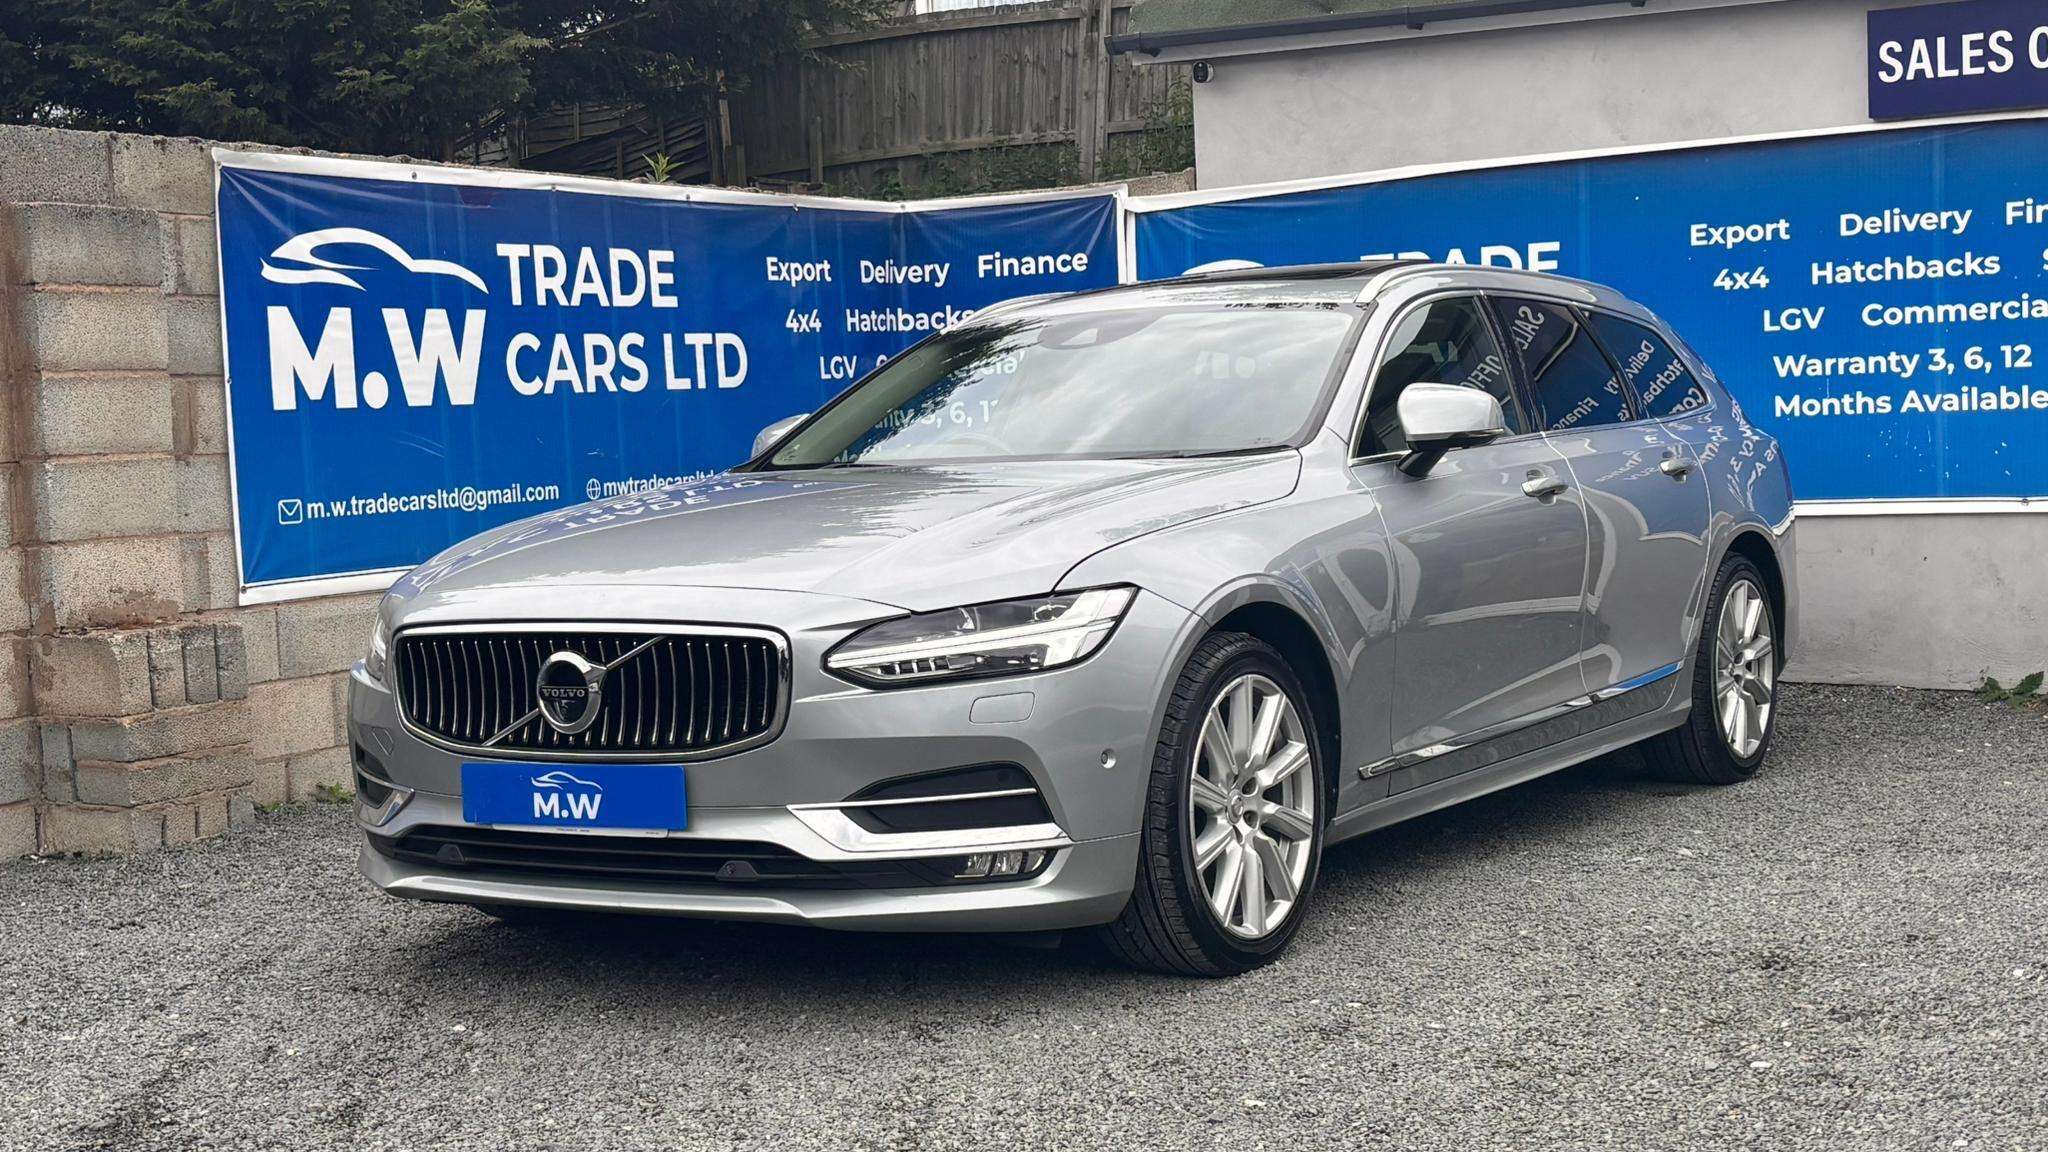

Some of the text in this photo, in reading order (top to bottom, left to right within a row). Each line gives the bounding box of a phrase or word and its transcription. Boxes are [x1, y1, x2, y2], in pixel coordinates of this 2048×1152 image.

[1878, 29, 2014, 83] SALES
[1690, 219, 1790, 250] Export
[1840, 207, 1972, 236] Delivery
[496, 244, 678, 307] TRADE
[766, 251, 1088, 286] Export Delivery Finance
[1713, 251, 2000, 291] 4x4 Hatchbacks
[785, 309, 822, 333] 4x4
[1763, 306, 1825, 332] LGV
[267, 305, 487, 411] M.W
[506, 332, 748, 396] CARS LTD
[819, 355, 857, 380] LGV
[1772, 344, 2033, 378] Warranty 3, 6, 12
[1774, 384, 2048, 418] Months Available
[307, 483, 560, 519] m.w.tradecarsltd@gmail.com
[542, 688, 585, 697] VOLVO
[534, 793, 602, 820] M.W
